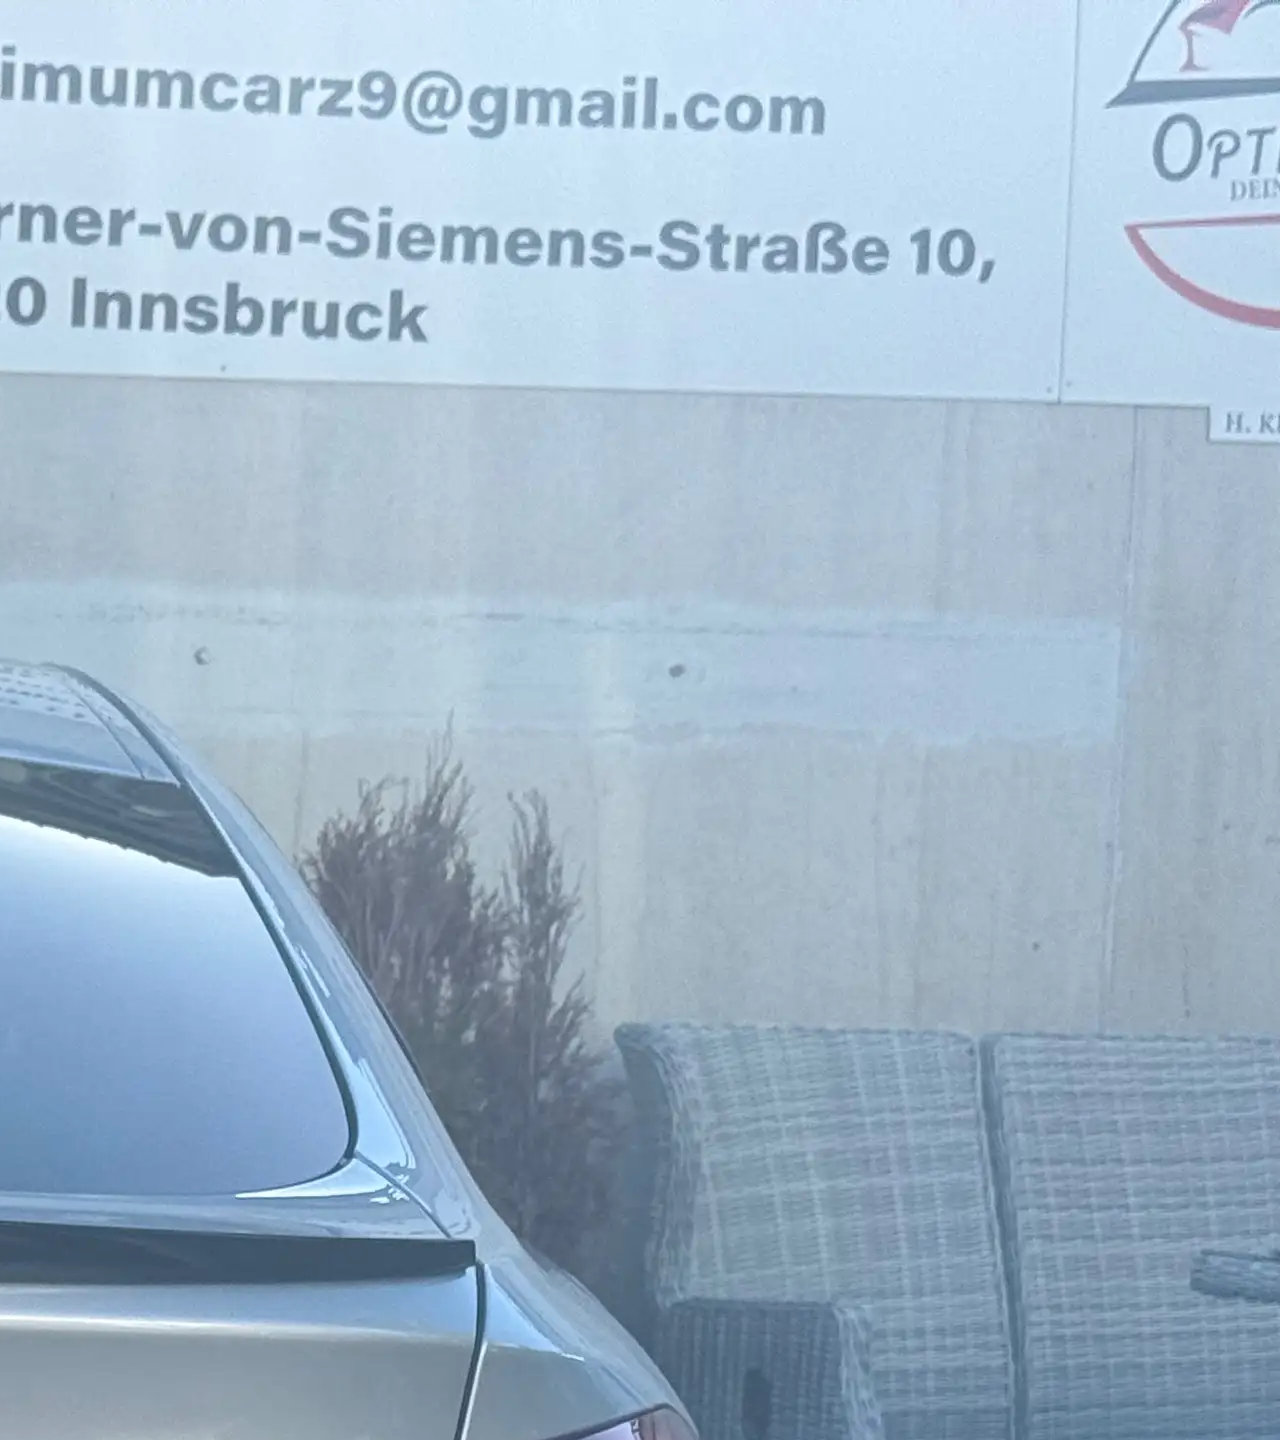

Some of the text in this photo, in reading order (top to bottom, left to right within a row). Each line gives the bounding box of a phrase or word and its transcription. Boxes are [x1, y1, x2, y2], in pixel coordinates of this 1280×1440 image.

[1152, 112, 1280, 182] OPT
[909, 227, 996, 284] 10,
[70, 276, 429, 344] Innsbruck
